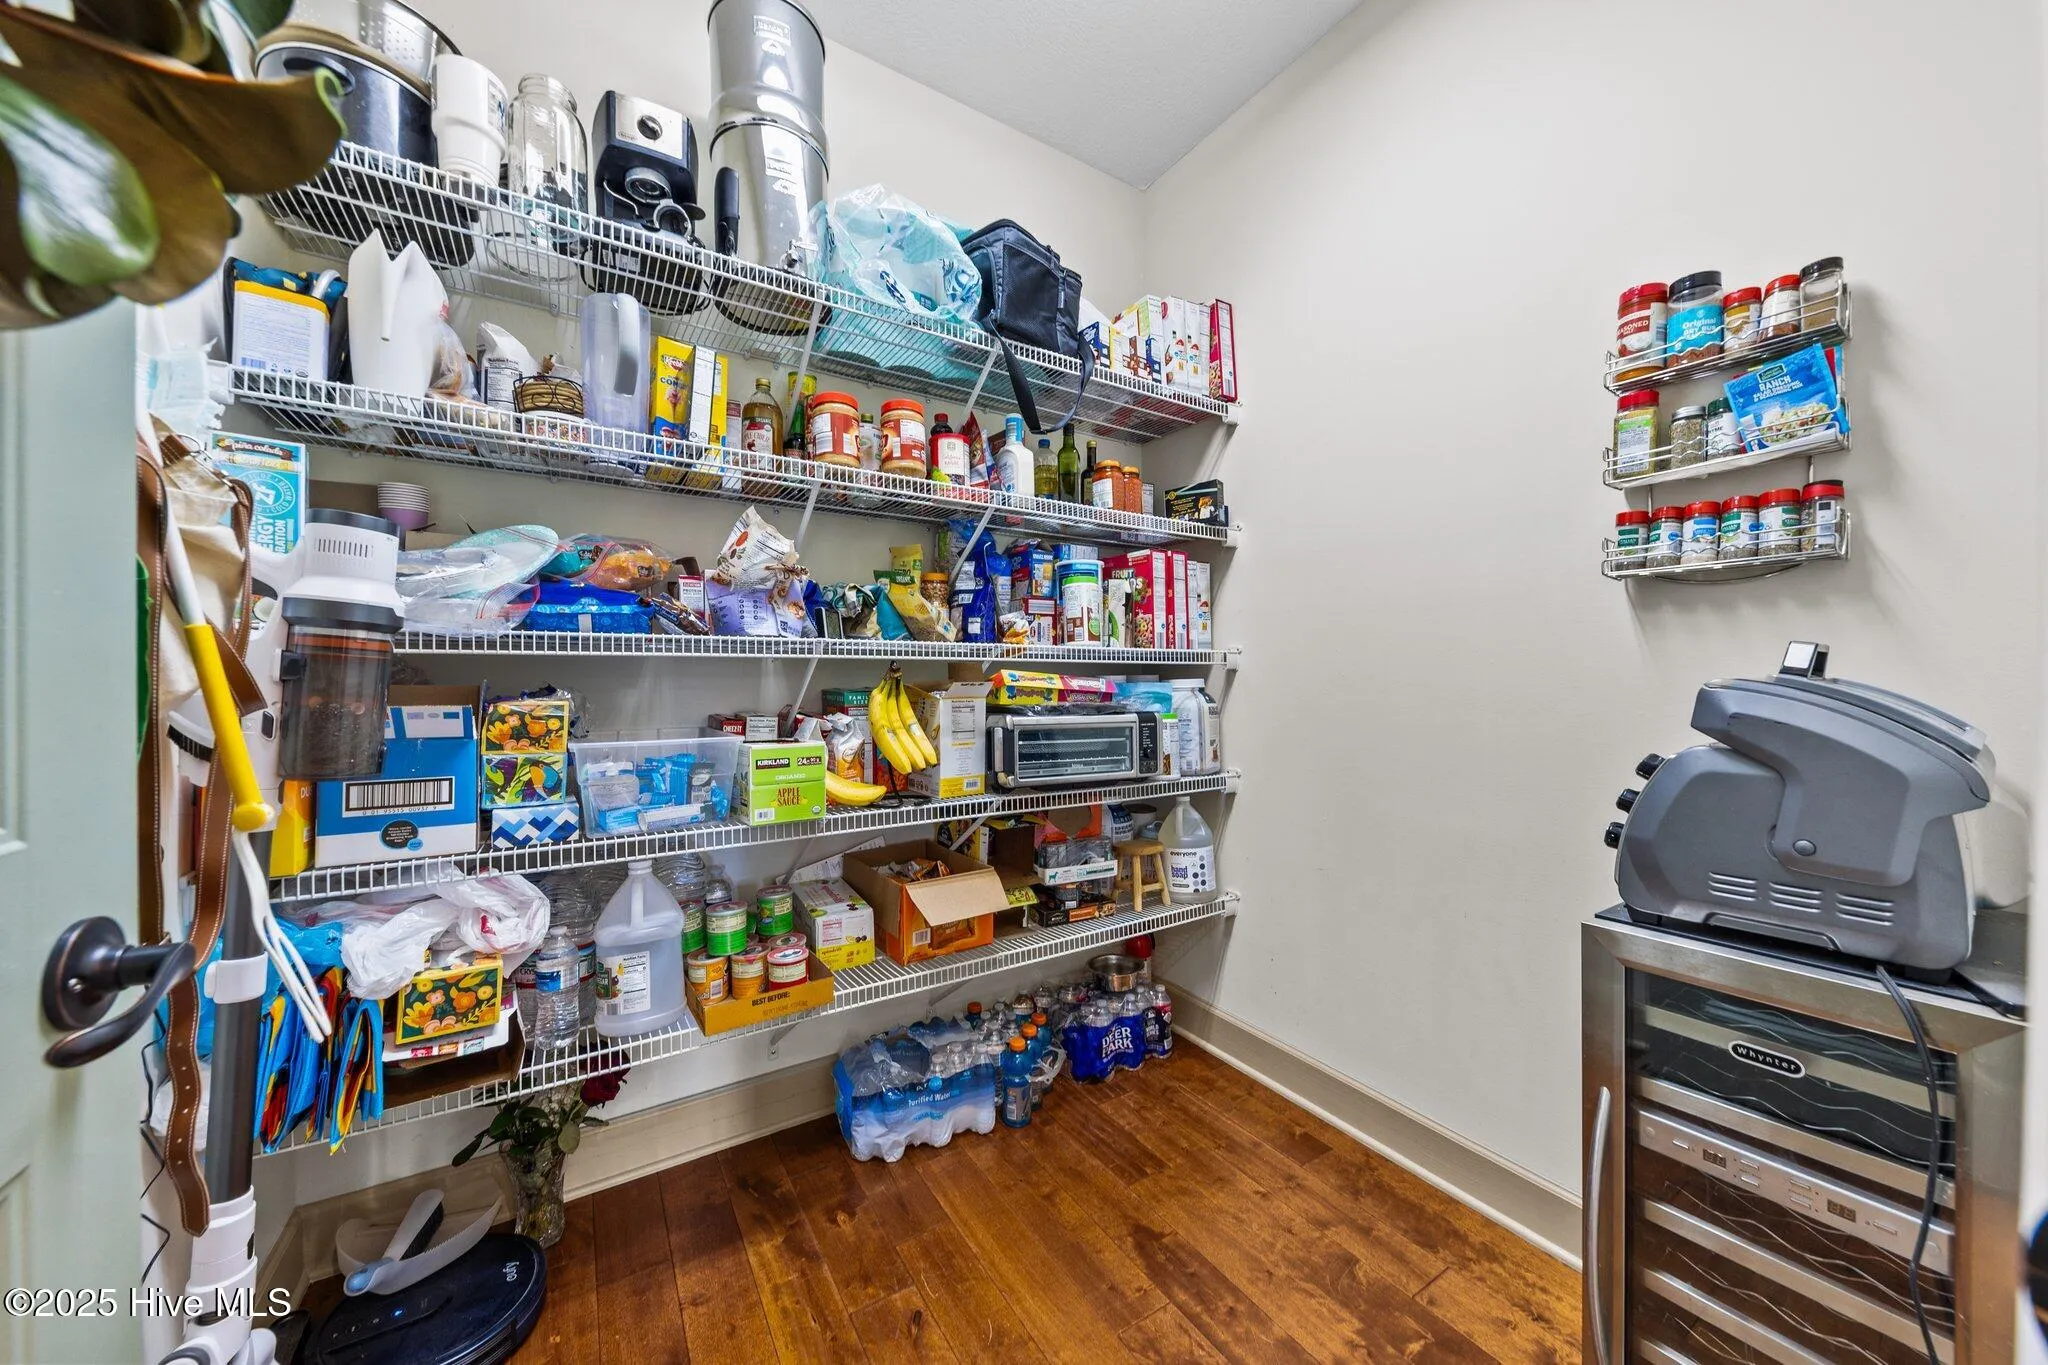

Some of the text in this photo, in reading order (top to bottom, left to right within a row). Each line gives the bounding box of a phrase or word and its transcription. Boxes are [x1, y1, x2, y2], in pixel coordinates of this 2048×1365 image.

[1759, 375, 1791, 391] RANCH
[1112, 568, 1134, 579] FRUIT
[757, 758, 789, 766] KIRKLAND
[777, 787, 801, 797] APPLE
[777, 797, 801, 807] SAUCE
[751, 997, 766, 1006] BEST
[1102, 1026, 1132, 1049] DEER
[1102, 1038, 1134, 1058] PARK
[1736, 1045, 1797, 1072] Whynter
[908, 1094, 934, 1107] Purified
[502, 1261, 520, 1282] eufy
